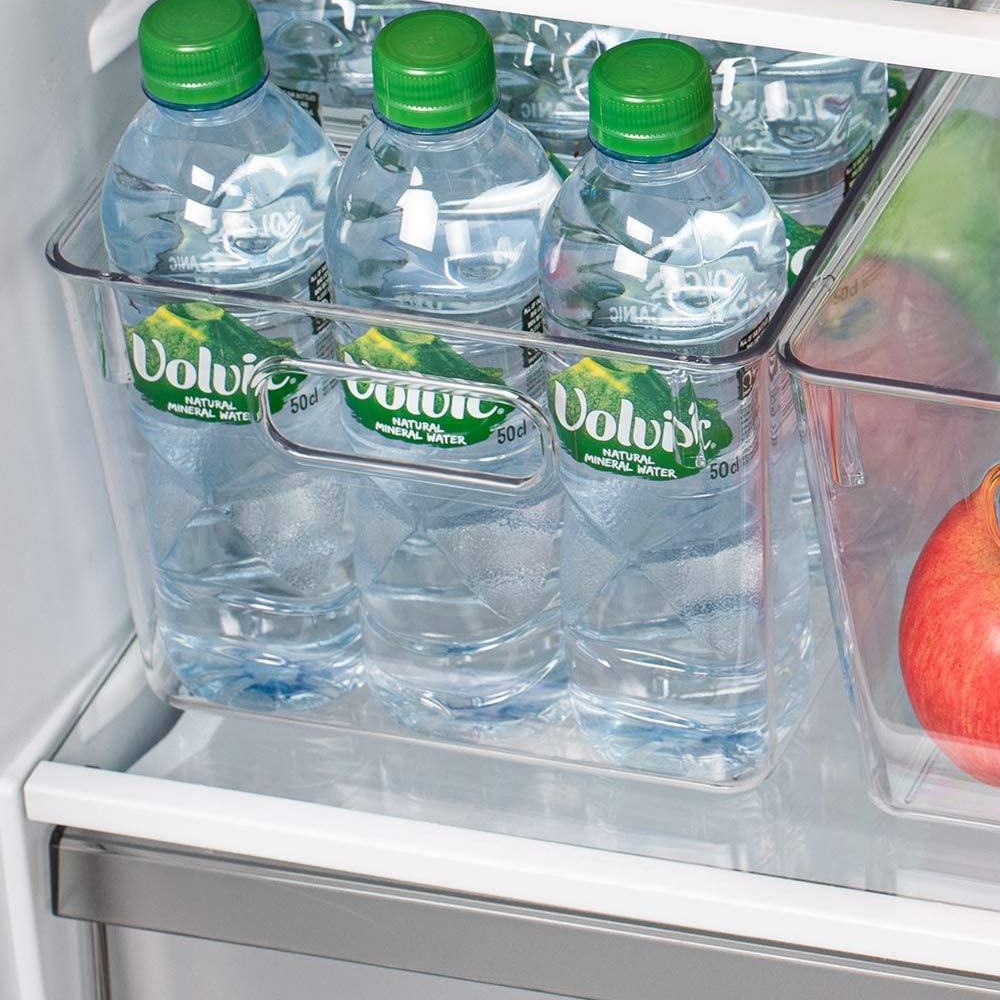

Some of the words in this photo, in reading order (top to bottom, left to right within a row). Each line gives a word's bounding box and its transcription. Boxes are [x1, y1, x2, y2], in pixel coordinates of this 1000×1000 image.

[168, 402, 216, 421] MINERAL
[184, 396, 238, 411] NATURAL
[375, 421, 423, 441] MINERAL
[426, 432, 467, 446] WATER
[392, 417, 445, 433] NATURAL
[602, 448, 655, 465] NATURAL
[584, 453, 633, 472] MINERAL
[637, 465, 678, 479] WATER
